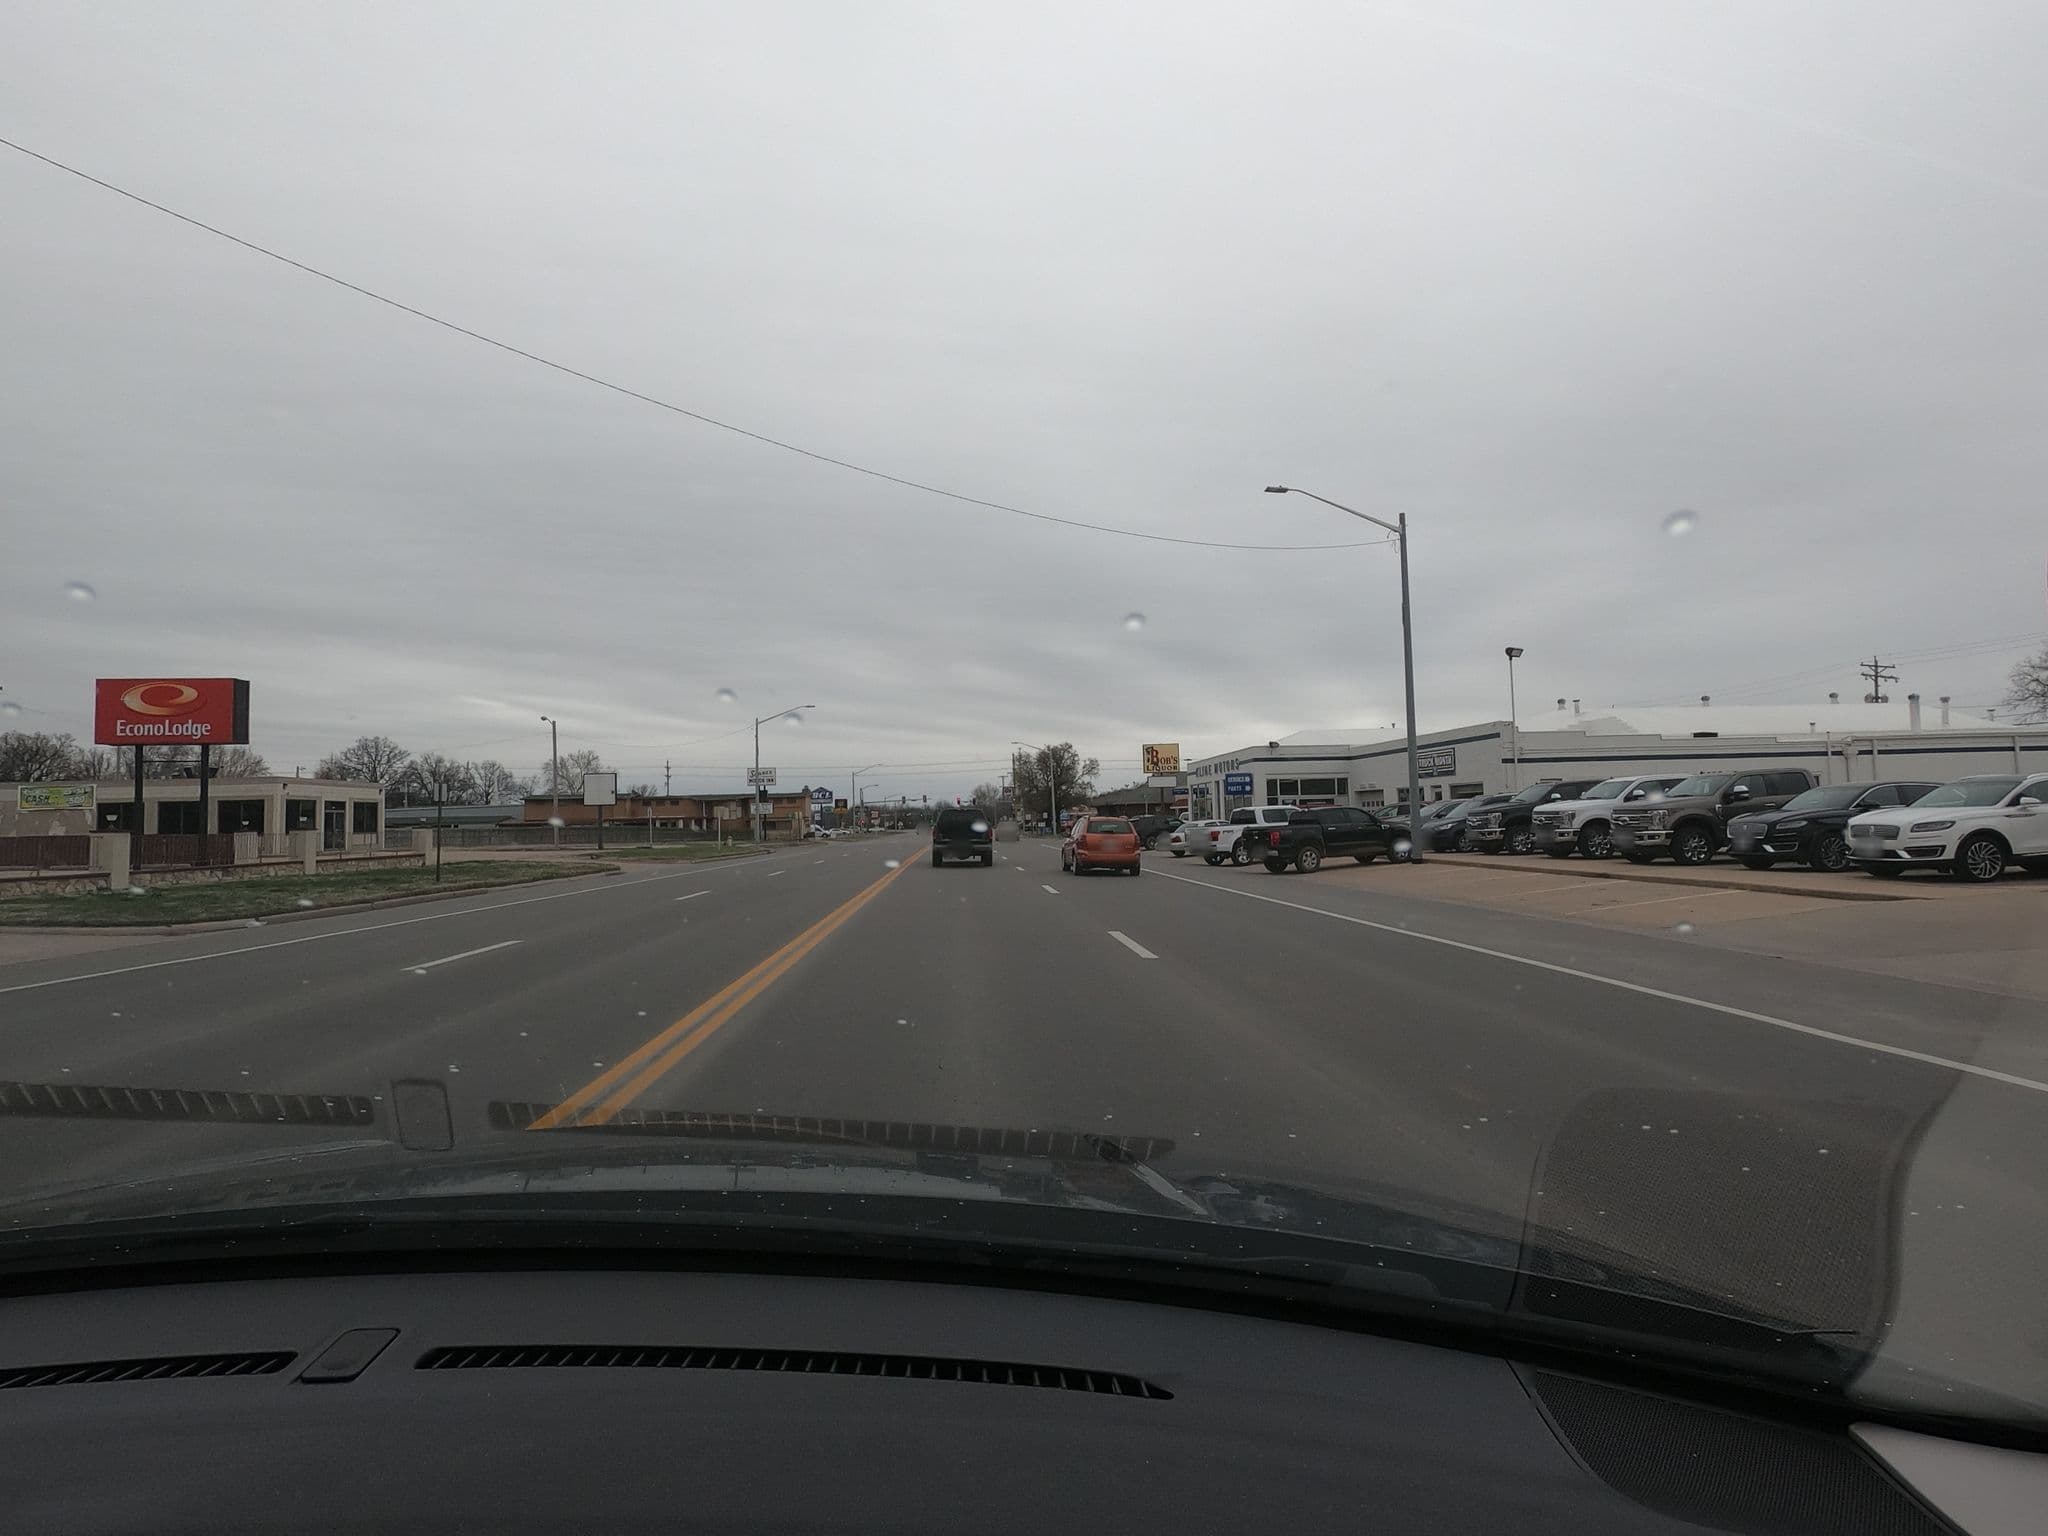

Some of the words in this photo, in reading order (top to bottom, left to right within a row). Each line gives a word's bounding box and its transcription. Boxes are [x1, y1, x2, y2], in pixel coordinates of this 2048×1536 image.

[116, 719, 211, 739] EconoLodge
[1213, 757, 1240, 774] MOTORS
[25, 794, 50, 804] CASH
